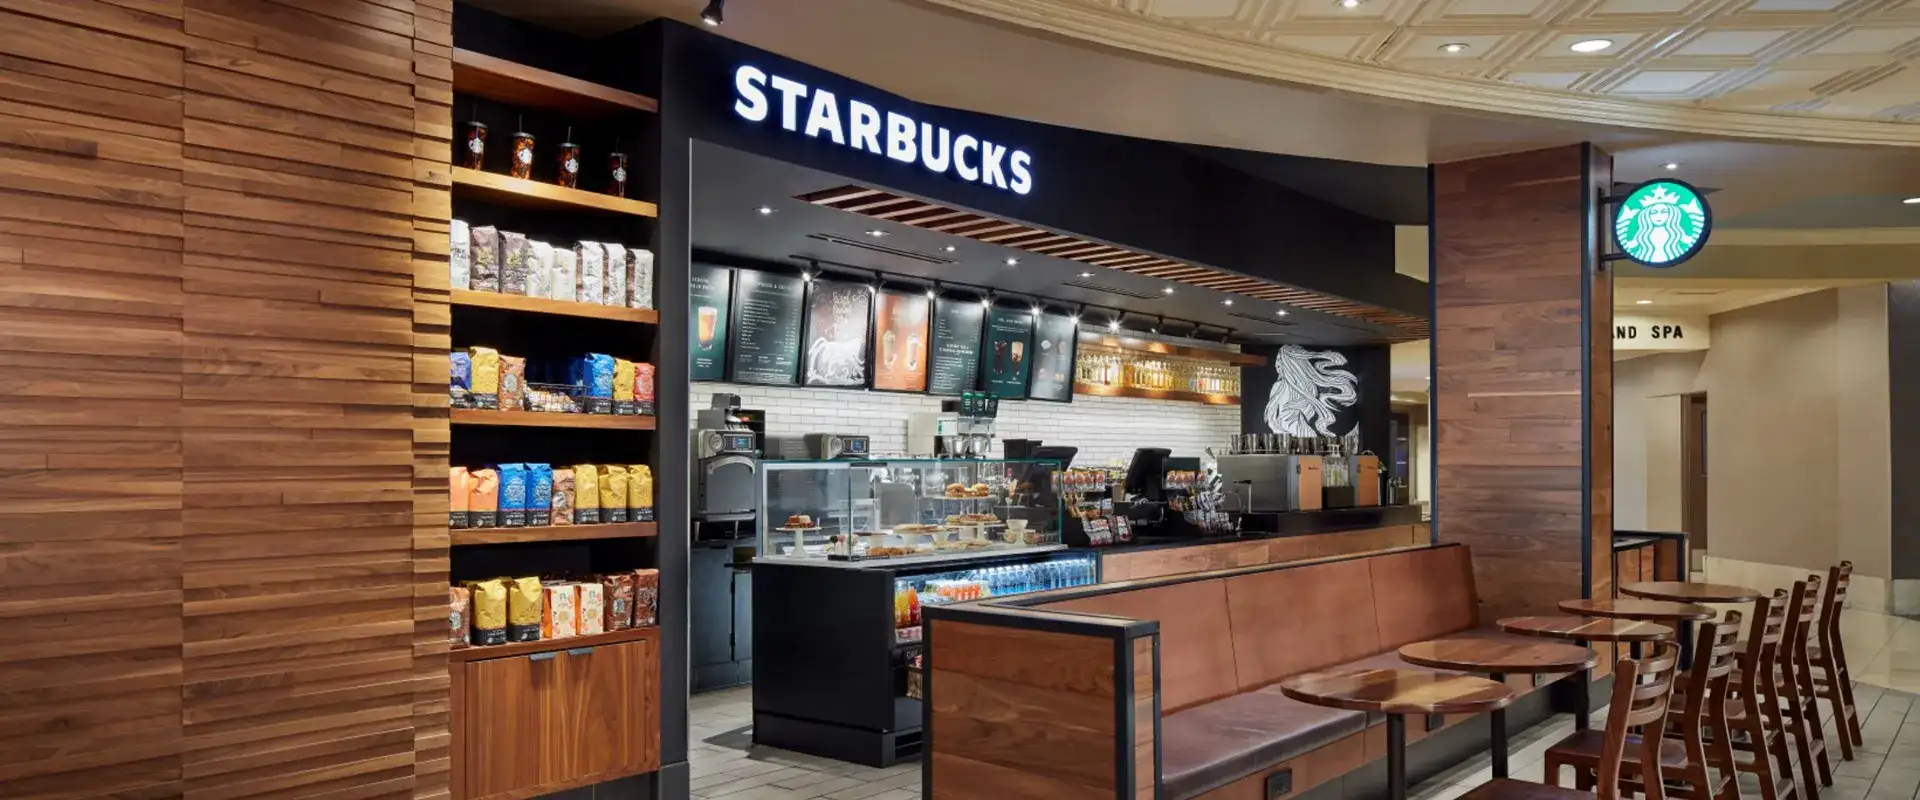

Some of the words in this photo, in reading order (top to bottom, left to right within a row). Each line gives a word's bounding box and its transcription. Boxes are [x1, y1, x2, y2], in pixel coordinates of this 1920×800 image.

[734, 65, 1032, 195] STARBUCKS
[1612, 326, 1637, 339] ND
[1651, 325, 1683, 339] SPA
